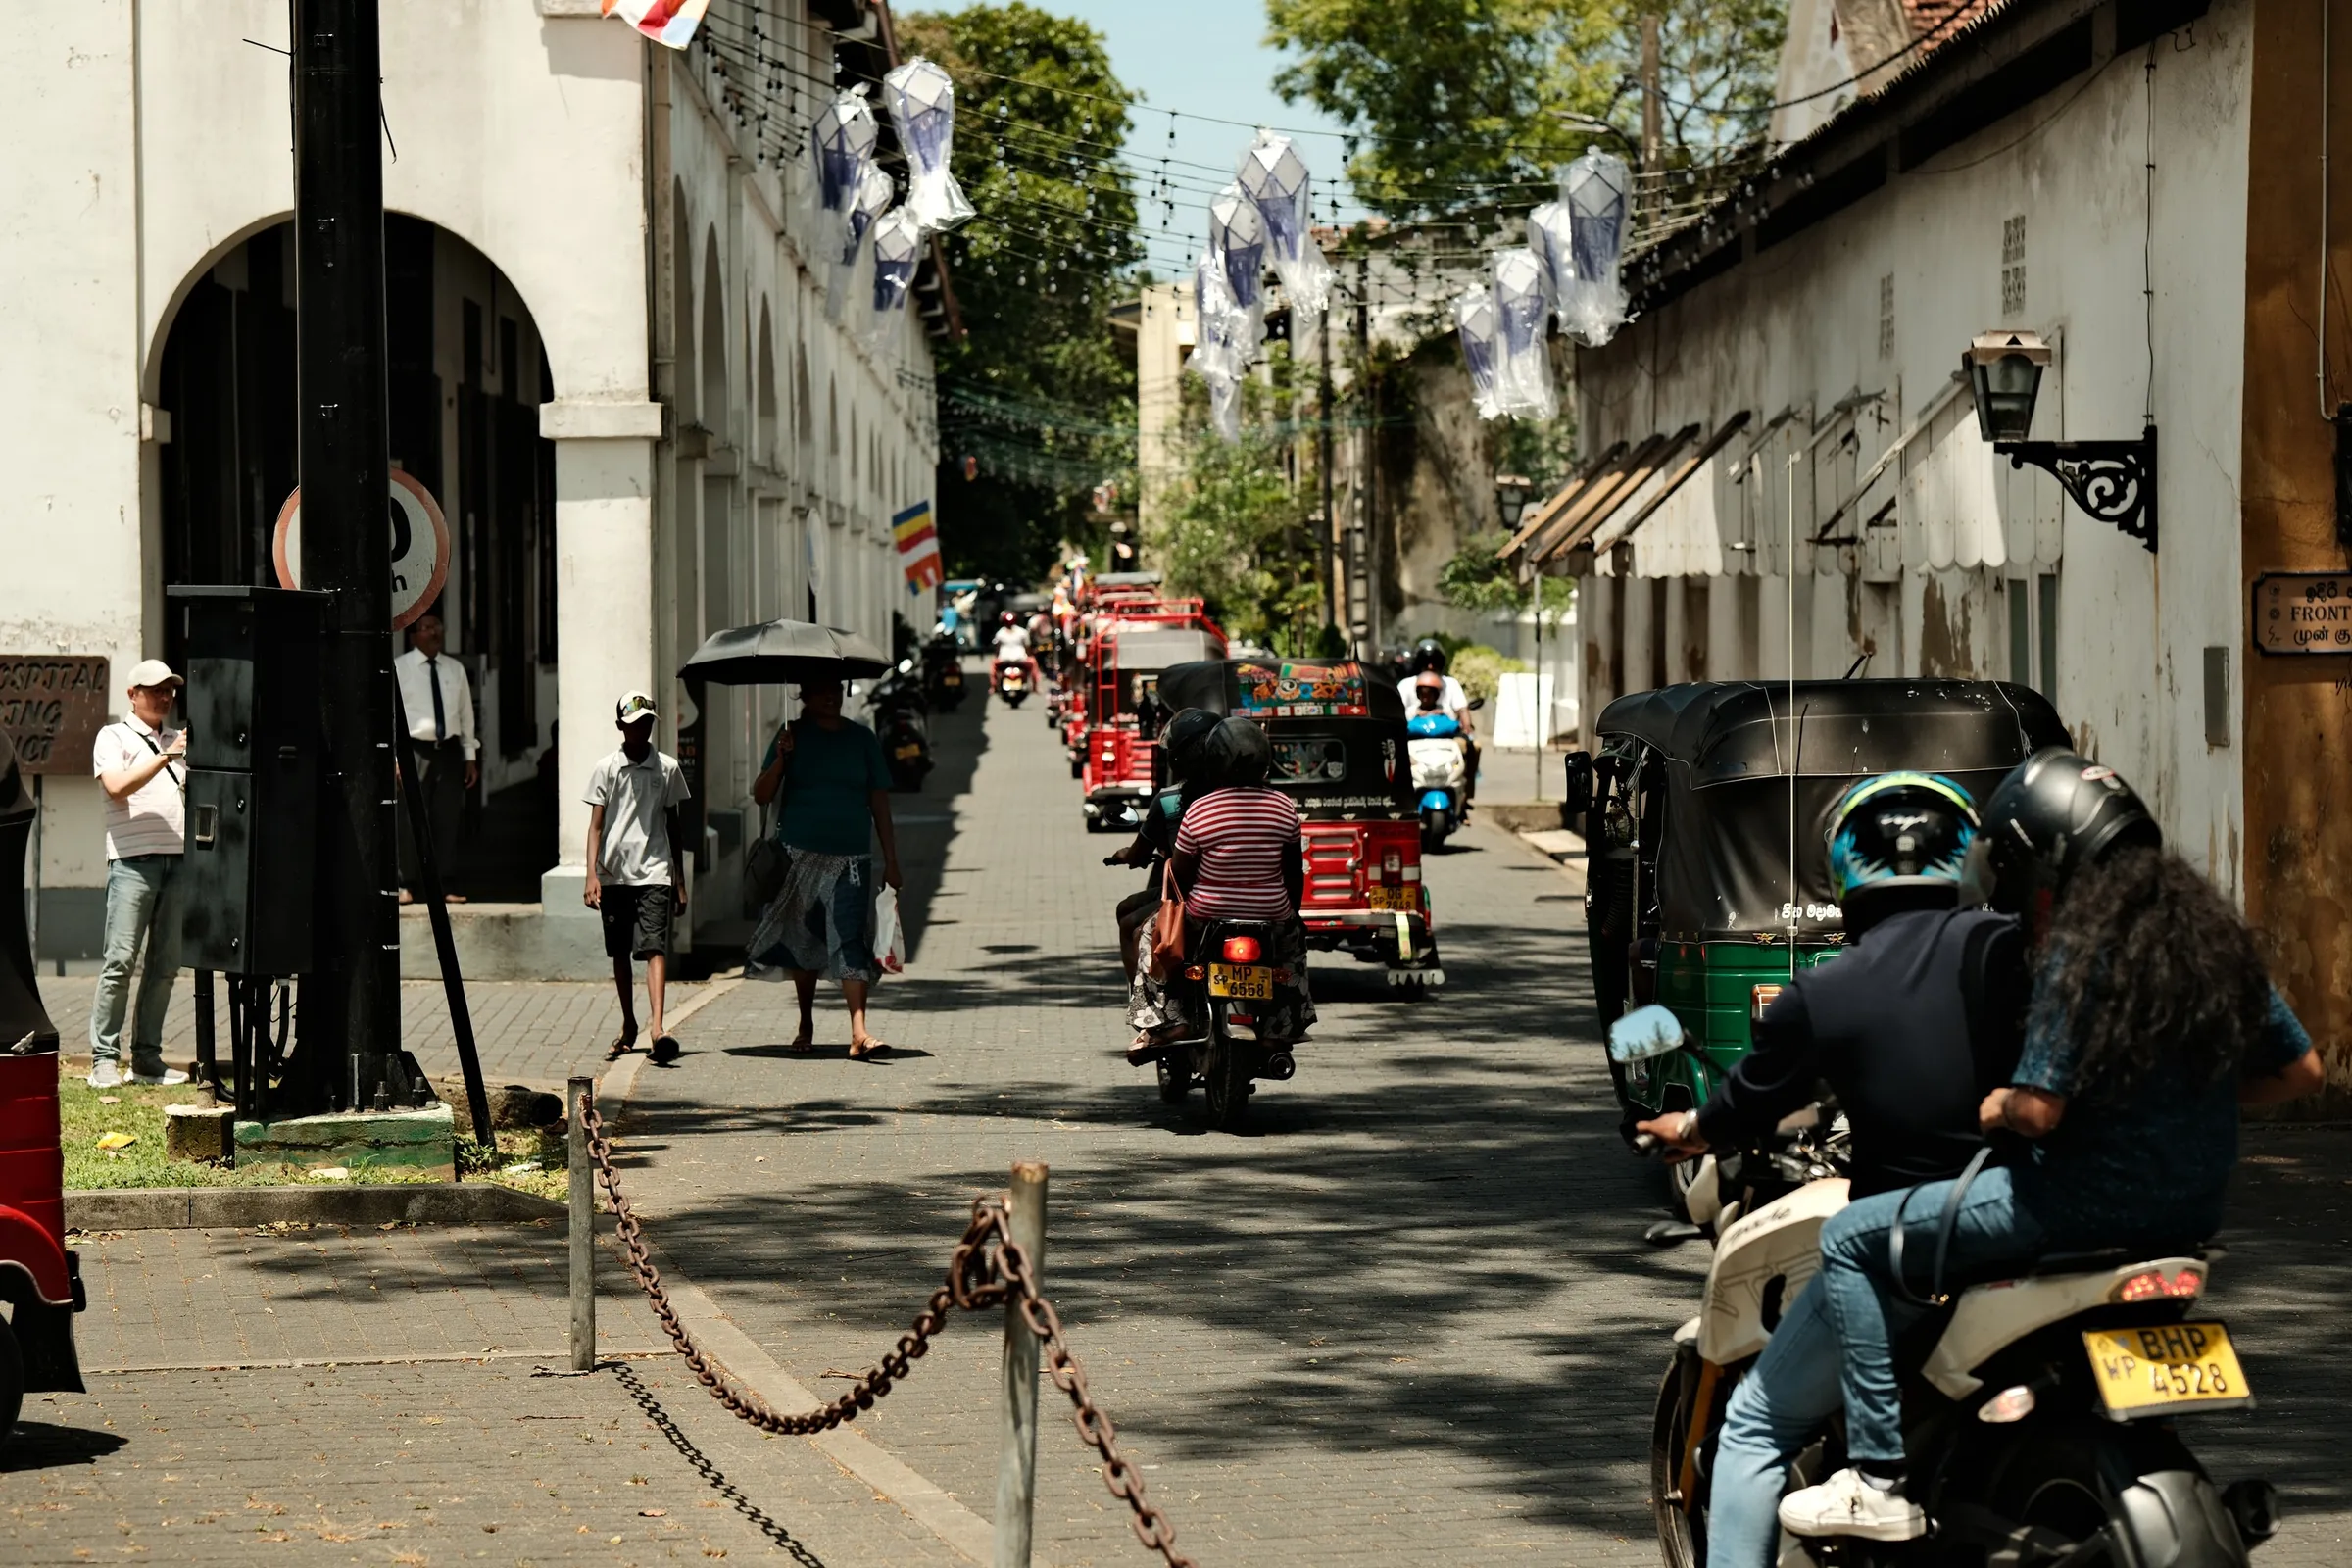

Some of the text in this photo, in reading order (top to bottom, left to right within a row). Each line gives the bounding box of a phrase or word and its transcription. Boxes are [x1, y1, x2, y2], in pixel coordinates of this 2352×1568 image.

[2290, 606, 2352, 622] FRONT
[2293, 625, 2328, 646] முன்
[0, 699, 62, 726] ING
[1232, 965, 1252, 981] MP
[1230, 981, 1265, 998] 6558
[2136, 1326, 2208, 1361] BHP
[2102, 1354, 2136, 1380] WP
[2151, 1362, 2228, 1396] 4528
